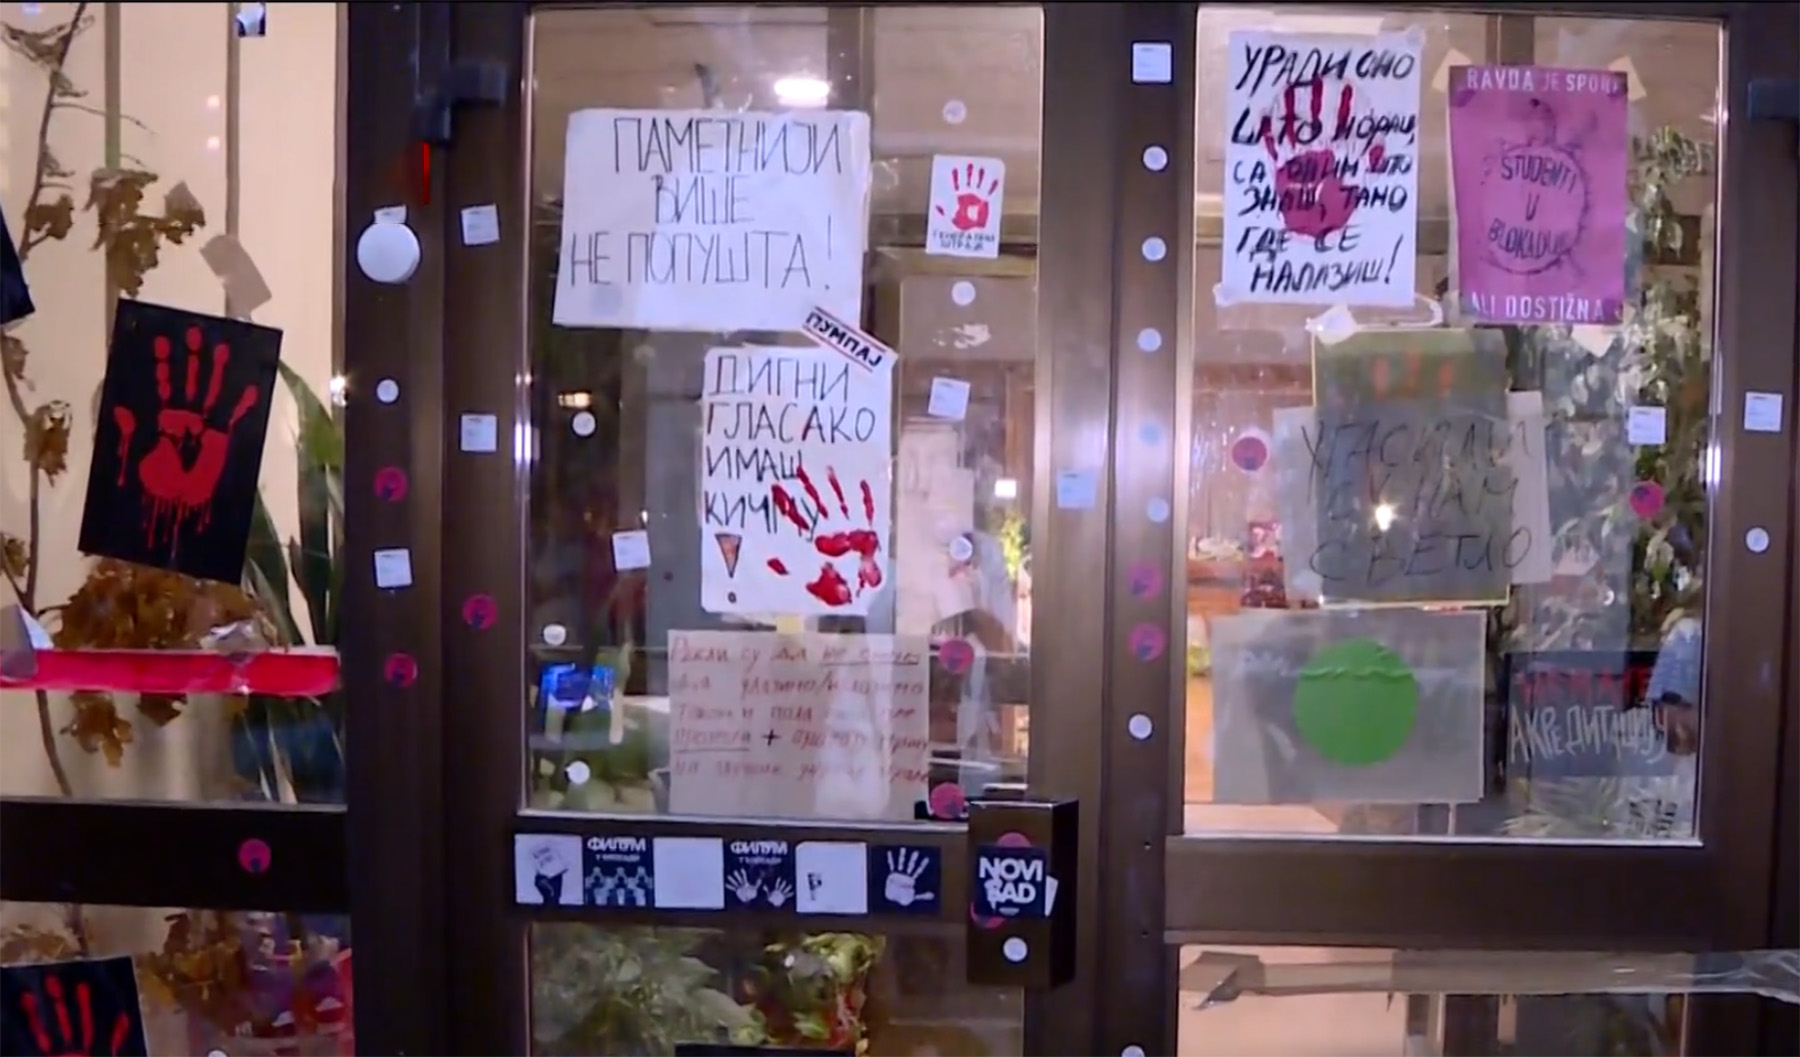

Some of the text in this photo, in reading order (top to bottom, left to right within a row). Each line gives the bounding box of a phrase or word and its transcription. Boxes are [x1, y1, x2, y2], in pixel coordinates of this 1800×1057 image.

[1235, 43, 1351, 97] УРАДИ
[1467, 67, 1534, 92] RAVDA
[1543, 72, 1560, 91] JE
[613, 117, 842, 175] ПАМЕТНИЈИ
[1233, 159, 1266, 184] СА
[1501, 154, 1577, 194] STUDENTI
[651, 174, 755, 225] ВИШЕ
[1526, 191, 1540, 221] U
[571, 231, 611, 287] НЕ
[1314, 225, 1361, 253] СЕ
[1505, 292, 1604, 321] DOSTIŽNA
[806, 312, 882, 367] ПУМПАЈ
[708, 355, 849, 403] ДИГНИ
[706, 446, 803, 483] ИМАШ
[1309, 527, 1533, 586] СВЕТЛО
[979, 856, 1043, 882] NOVI
